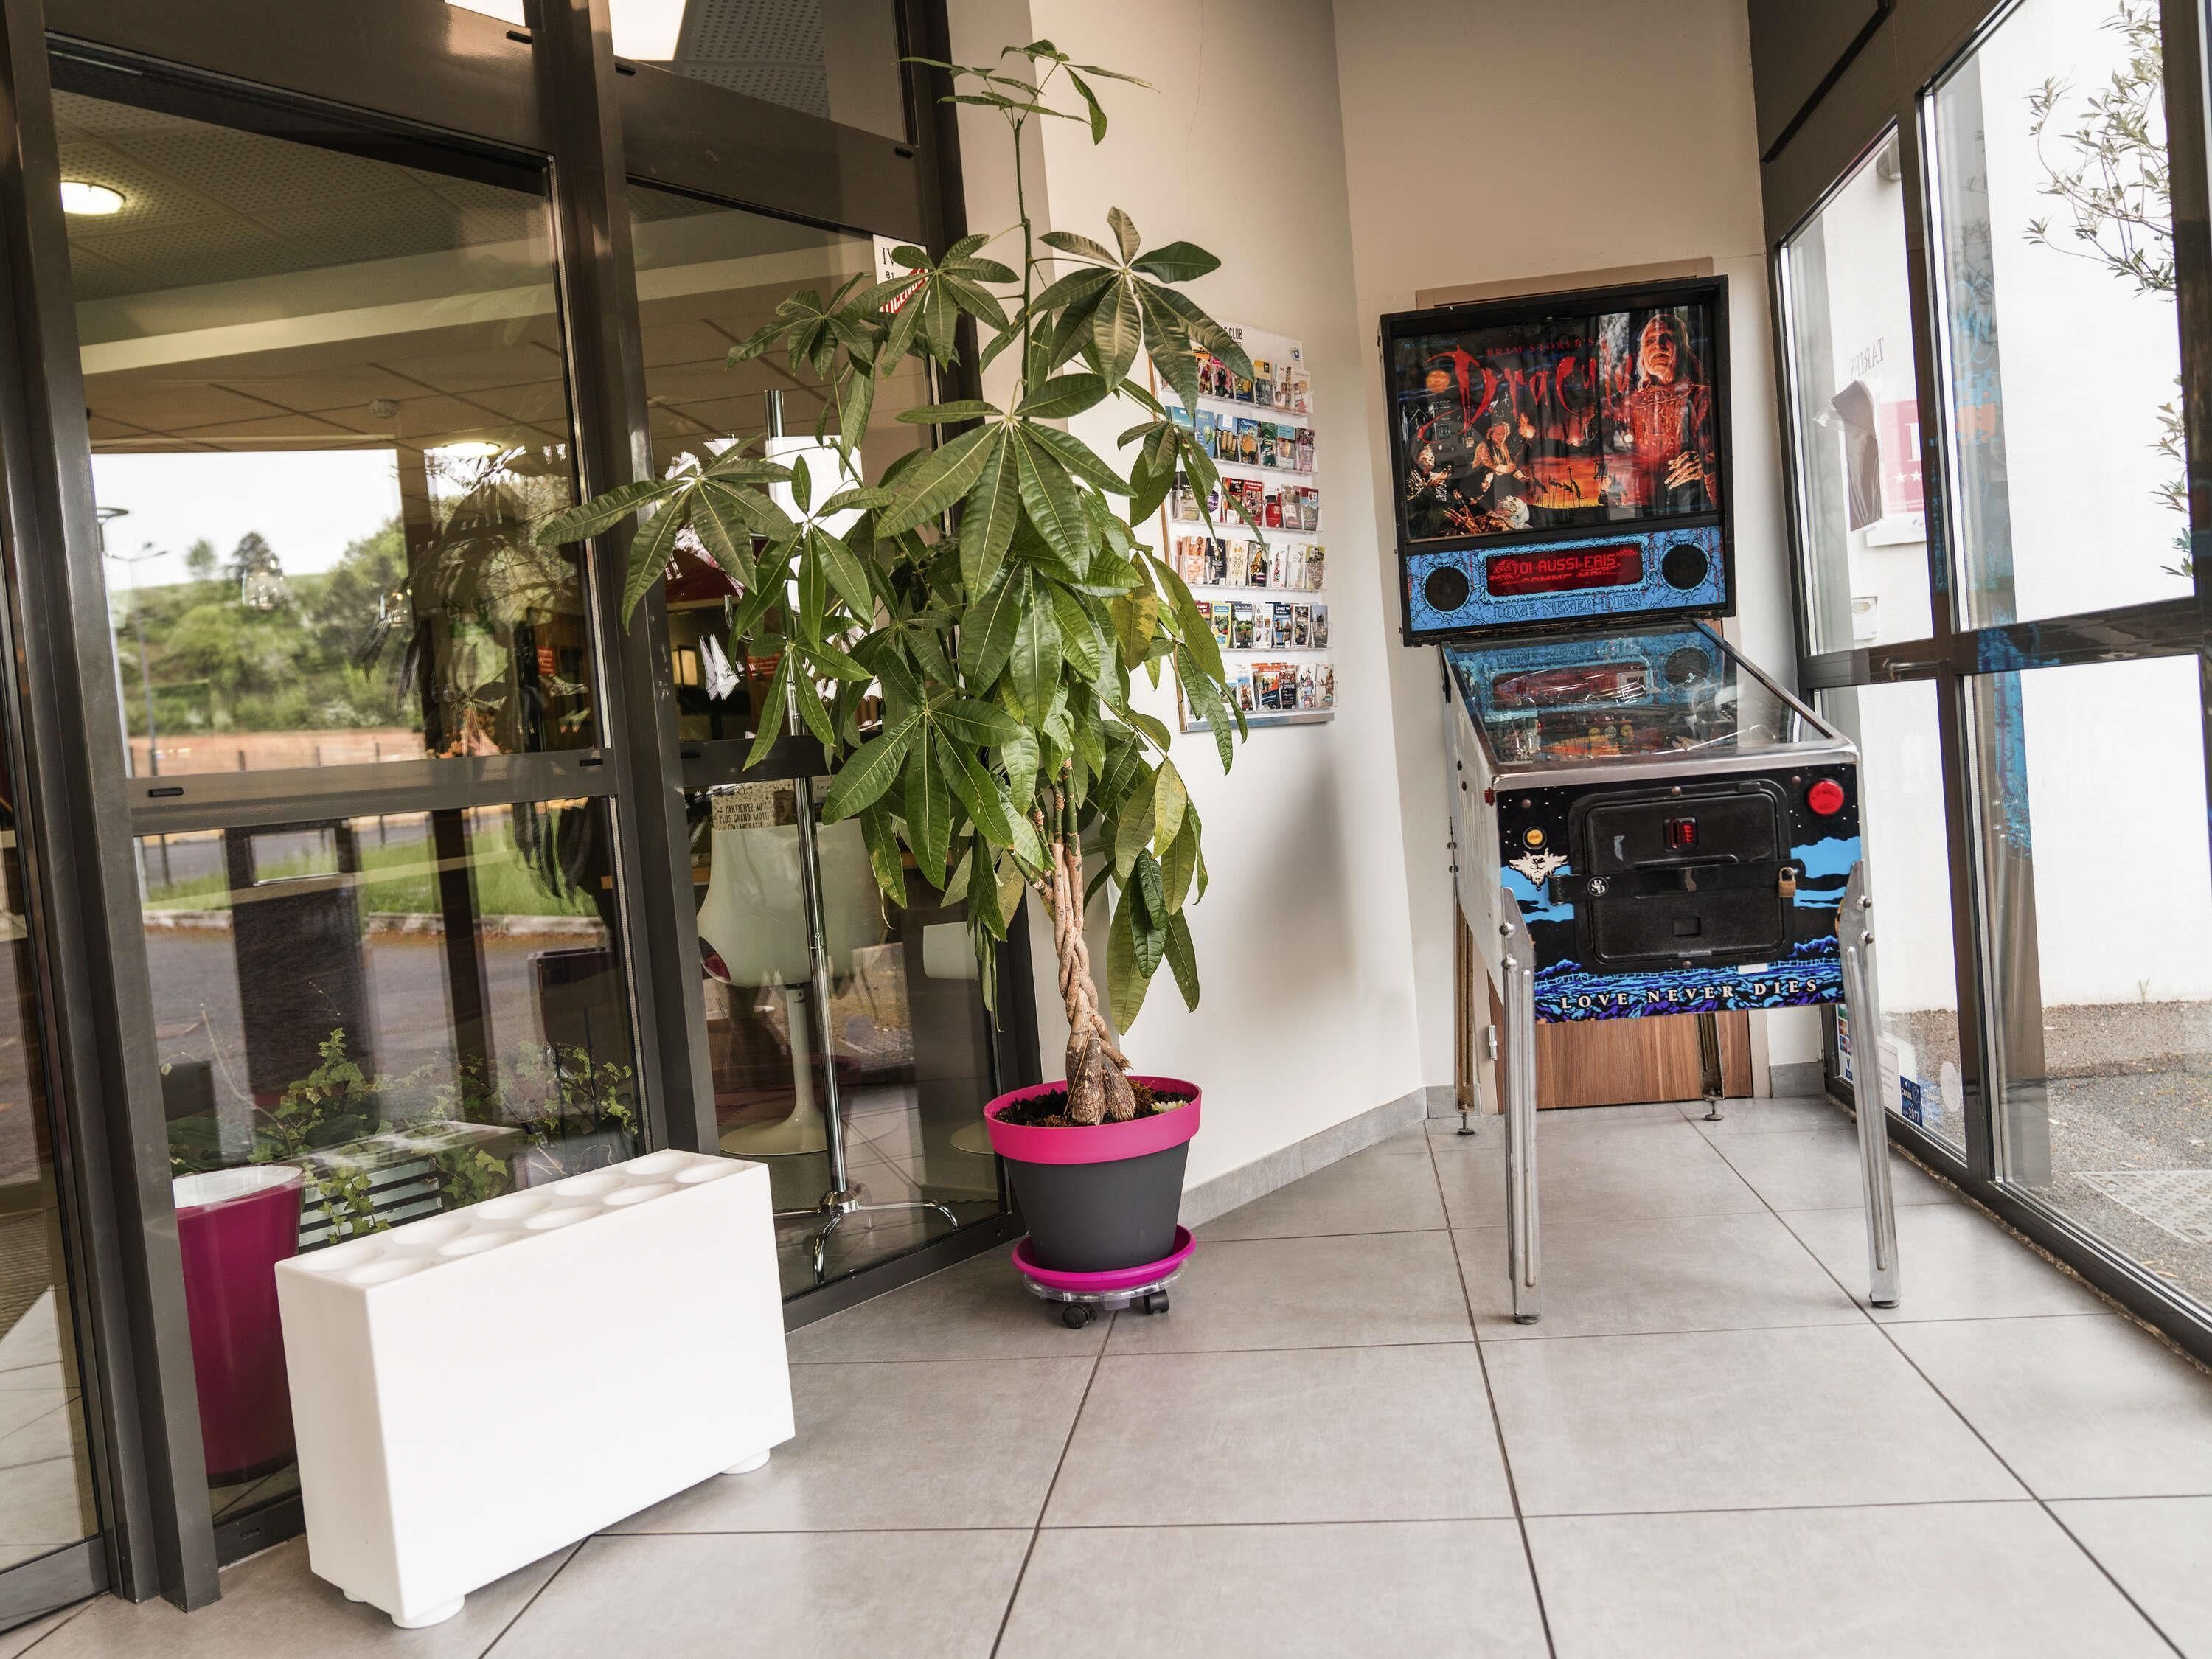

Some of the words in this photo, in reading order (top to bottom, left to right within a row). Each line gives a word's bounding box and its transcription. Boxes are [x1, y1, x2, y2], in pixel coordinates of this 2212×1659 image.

[1229, 327, 1243, 340] CLUB
[1486, 347, 1523, 358] BRAM
[1538, 557, 1579, 573] AUSSI
[1494, 602, 1537, 620] LOVE
[1543, 597, 1595, 615] NEVER
[1603, 593, 1642, 611] DIES
[726, 803, 754, 814] PARTICIPEZ
[756, 802, 762, 811] AU
[719, 815, 732, 824] PLUS
[734, 813, 751, 823] GRAND
[1562, 992, 1628, 1009] LOVE
[1647, 985, 1734, 1003] NEVER
[1754, 978, 1817, 996] DIES
